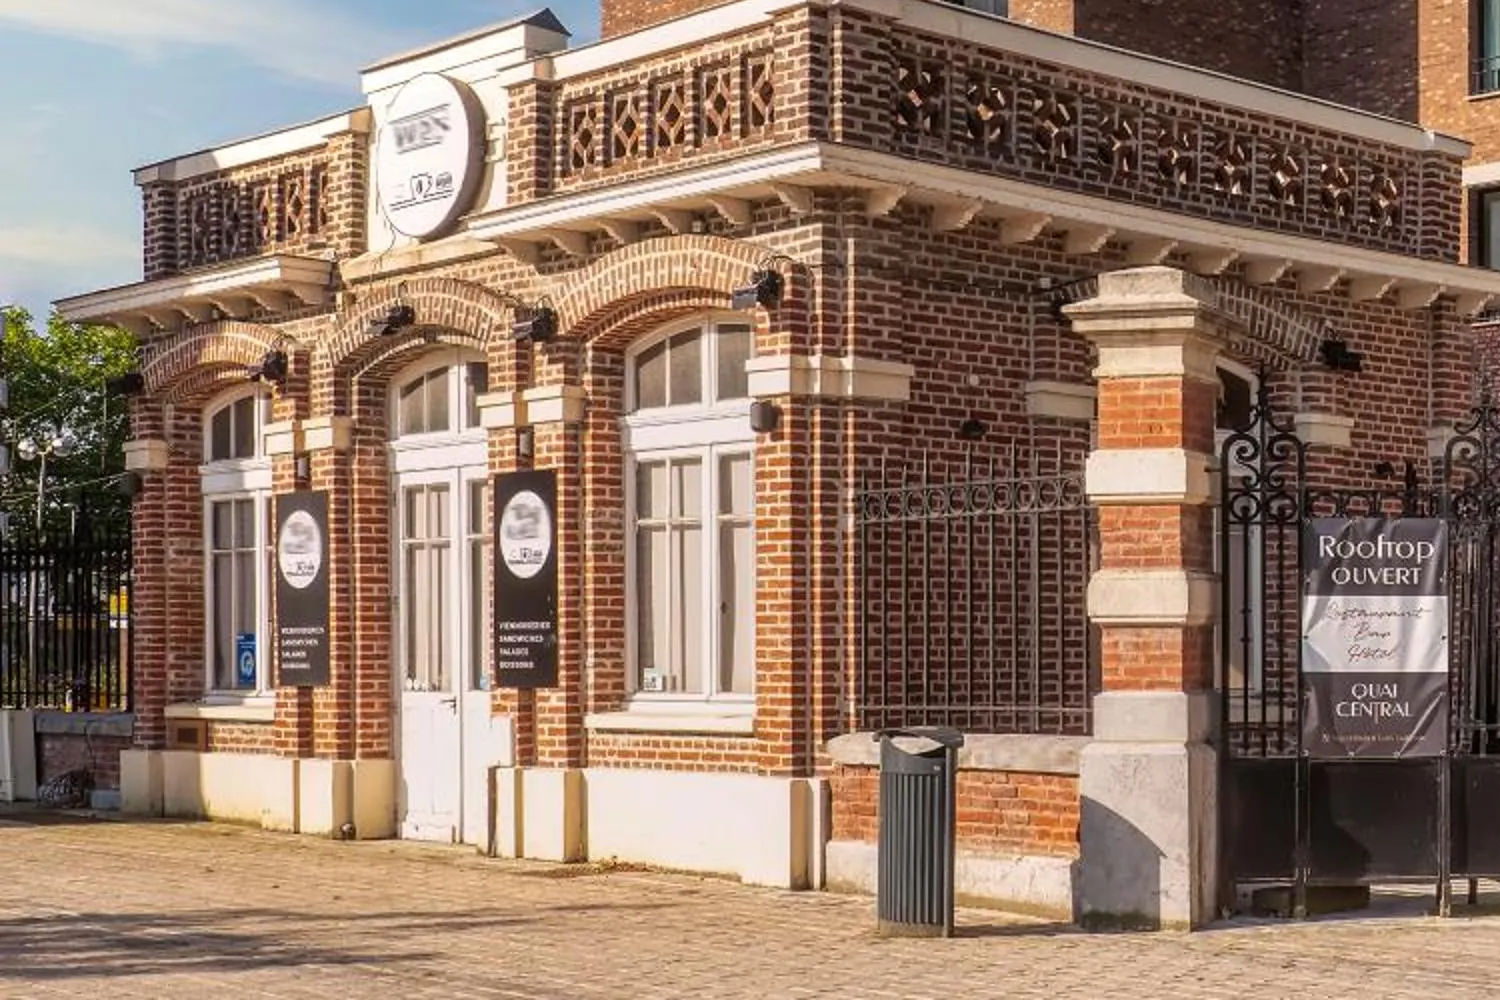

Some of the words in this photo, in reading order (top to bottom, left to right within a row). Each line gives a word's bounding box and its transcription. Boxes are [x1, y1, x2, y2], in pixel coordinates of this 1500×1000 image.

[1319, 534, 1436, 564] Rooftop
[1331, 567, 1423, 585] OUVERT
[1351, 682, 1399, 700] QUAI
[1336, 701, 1415, 725] CENTRAL
